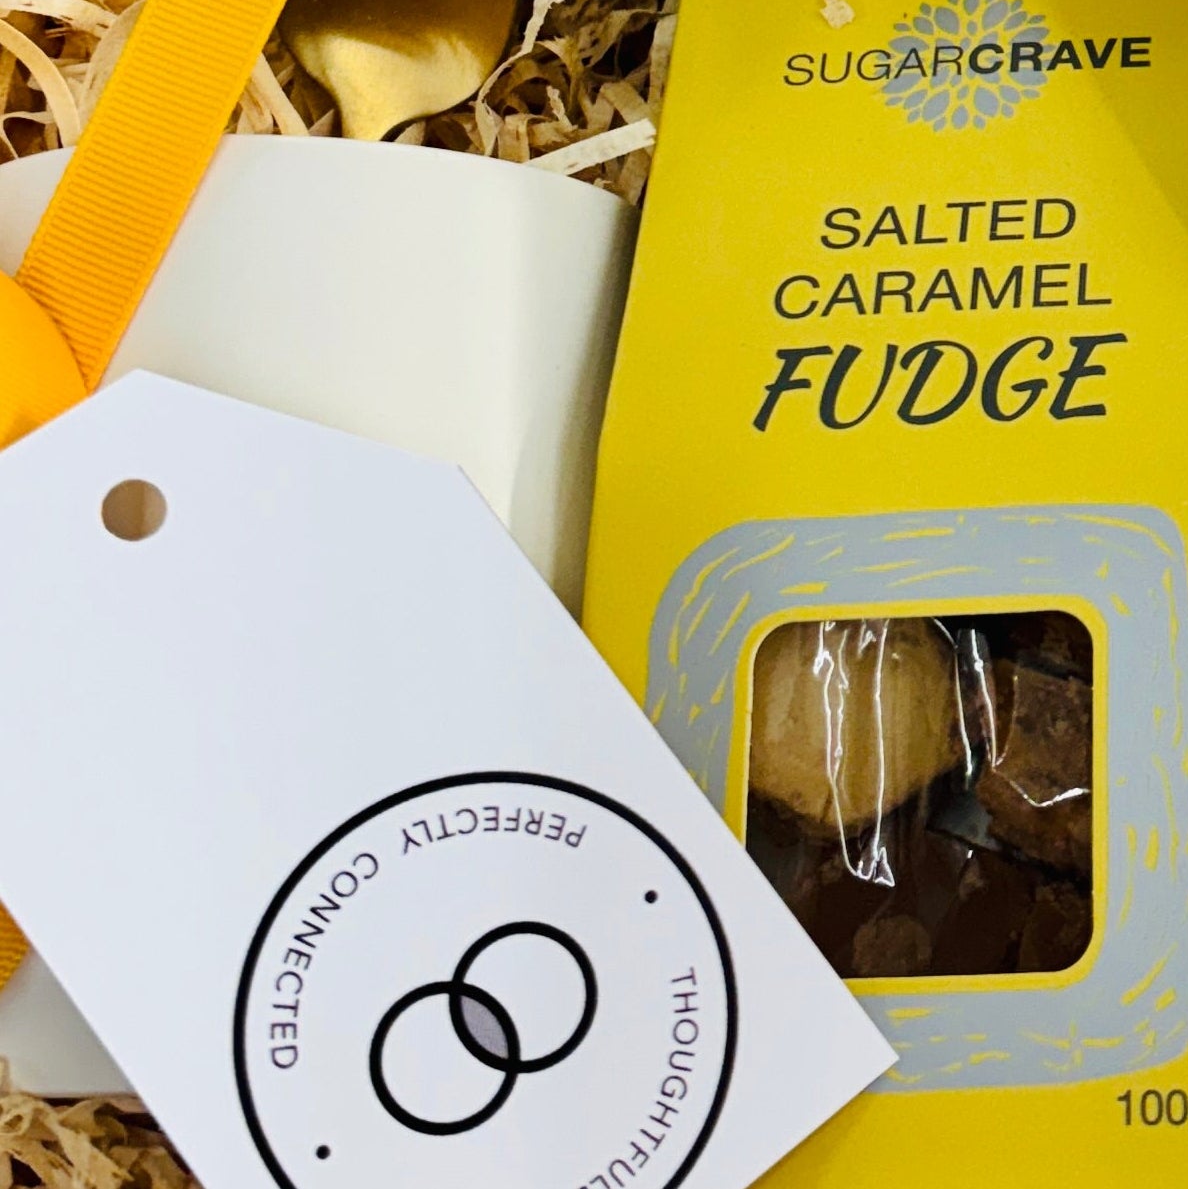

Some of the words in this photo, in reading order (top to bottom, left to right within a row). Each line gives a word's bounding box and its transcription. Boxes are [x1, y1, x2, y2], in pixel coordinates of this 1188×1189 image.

[783, 36, 1154, 86] SUGARCRAVE
[820, 197, 1076, 250] SALTED
[774, 263, 1113, 319] CARAMEL
[752, 332, 1128, 433] FUDGE
[400, 805, 588, 856] PERFECTLY
[269, 852, 381, 1071] CONNECTED
[580, 967, 699, 1189] THOUGHTFUL
